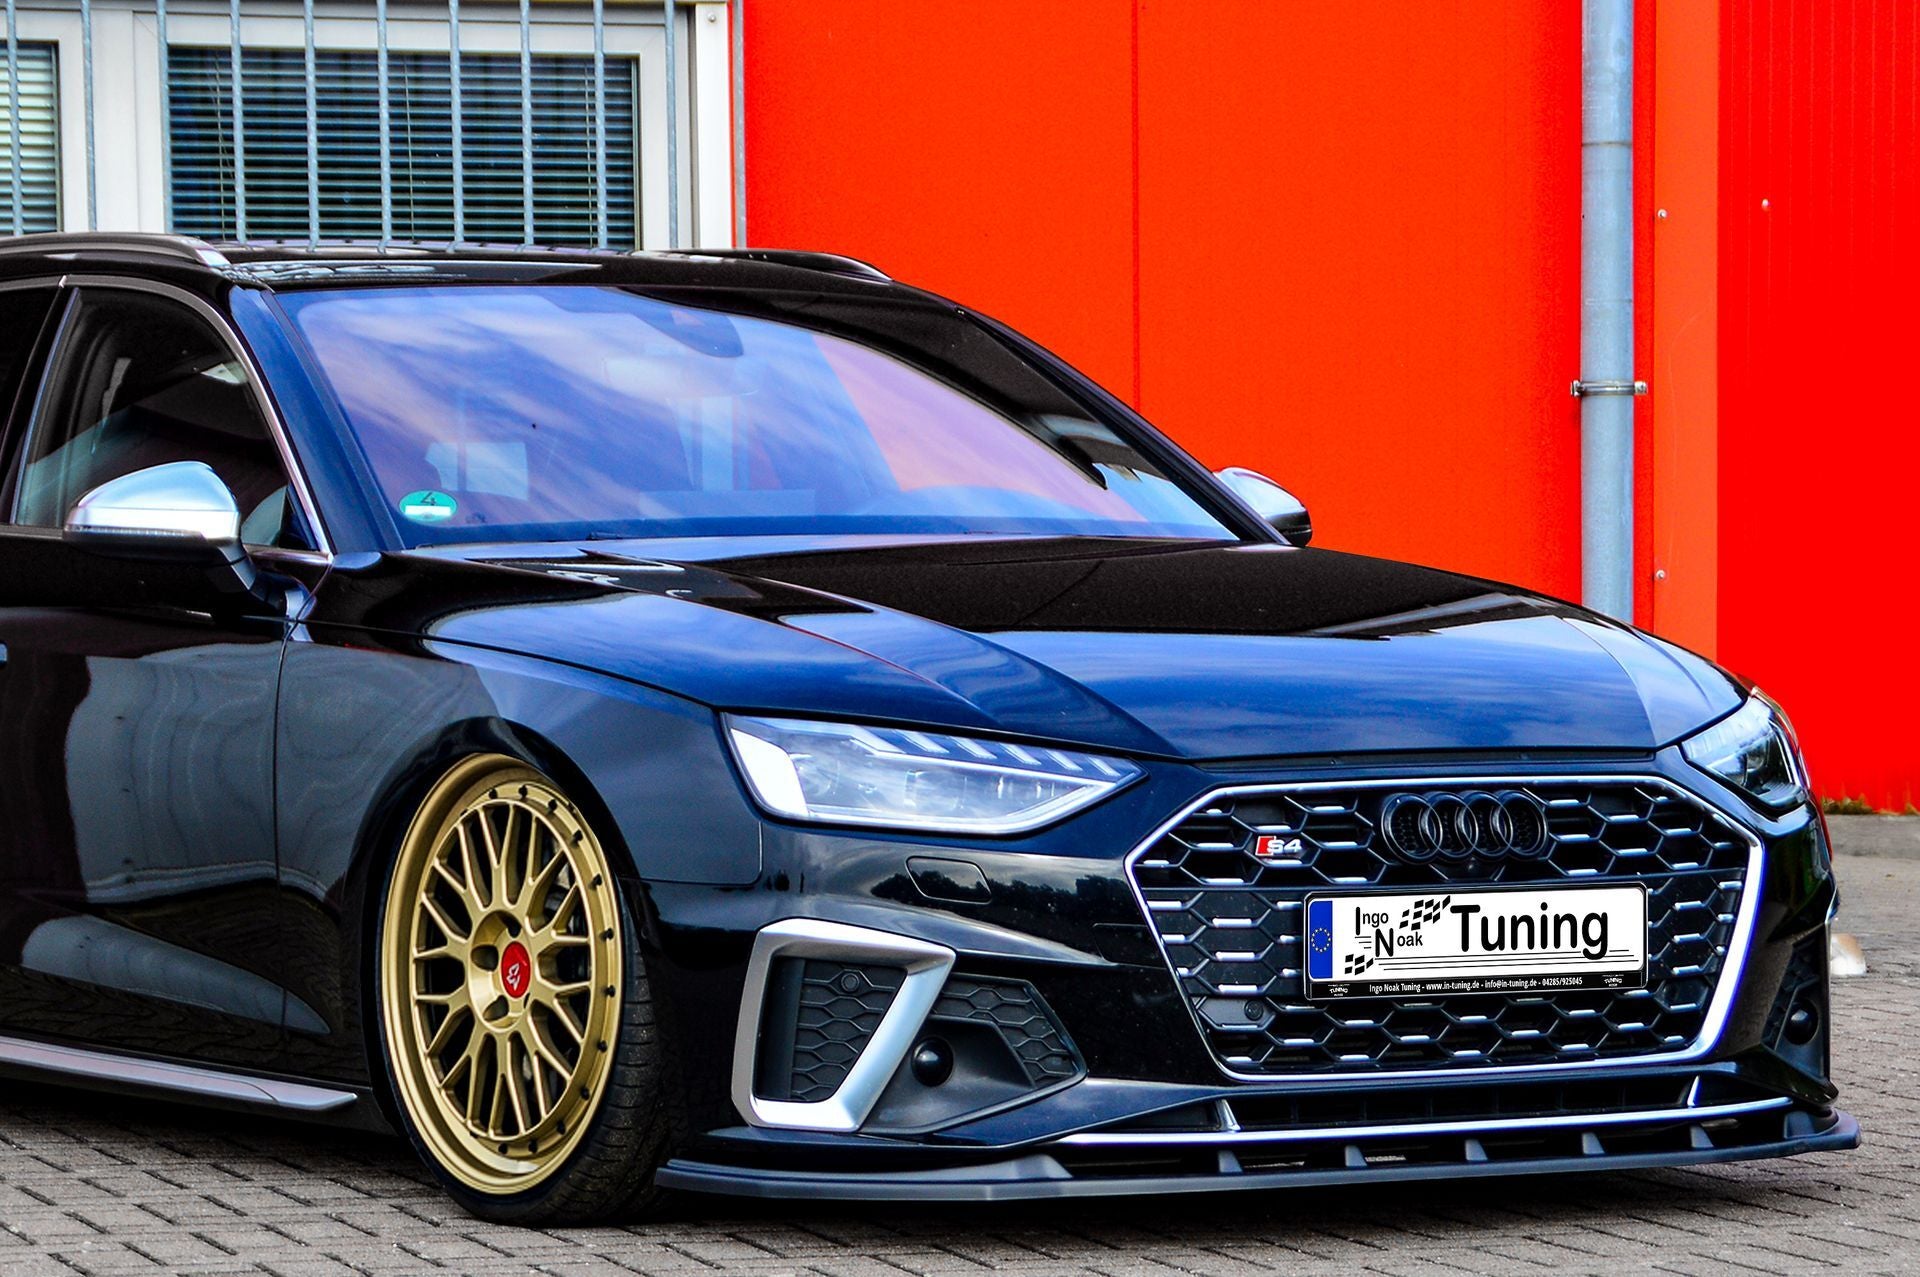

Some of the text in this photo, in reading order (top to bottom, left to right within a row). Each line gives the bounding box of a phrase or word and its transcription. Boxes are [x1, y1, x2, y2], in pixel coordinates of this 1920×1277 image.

[421, 492, 436, 506] 4
[1267, 839, 1302, 854] S4
[1356, 907, 1389, 935] Ingo
[1450, 902, 1608, 960] Tuning
[1375, 928, 1423, 957] Noak
[1369, 984, 1383, 994] Ingo
[1384, 983, 1399, 992] Noak
[1401, 982, 1421, 993] Tuning
[1426, 981, 1480, 991] www.in-tuning.de
[1485, 978, 1538, 989] info@in-tuning.de
[1541, 977, 1583, 987] 04285/925045
